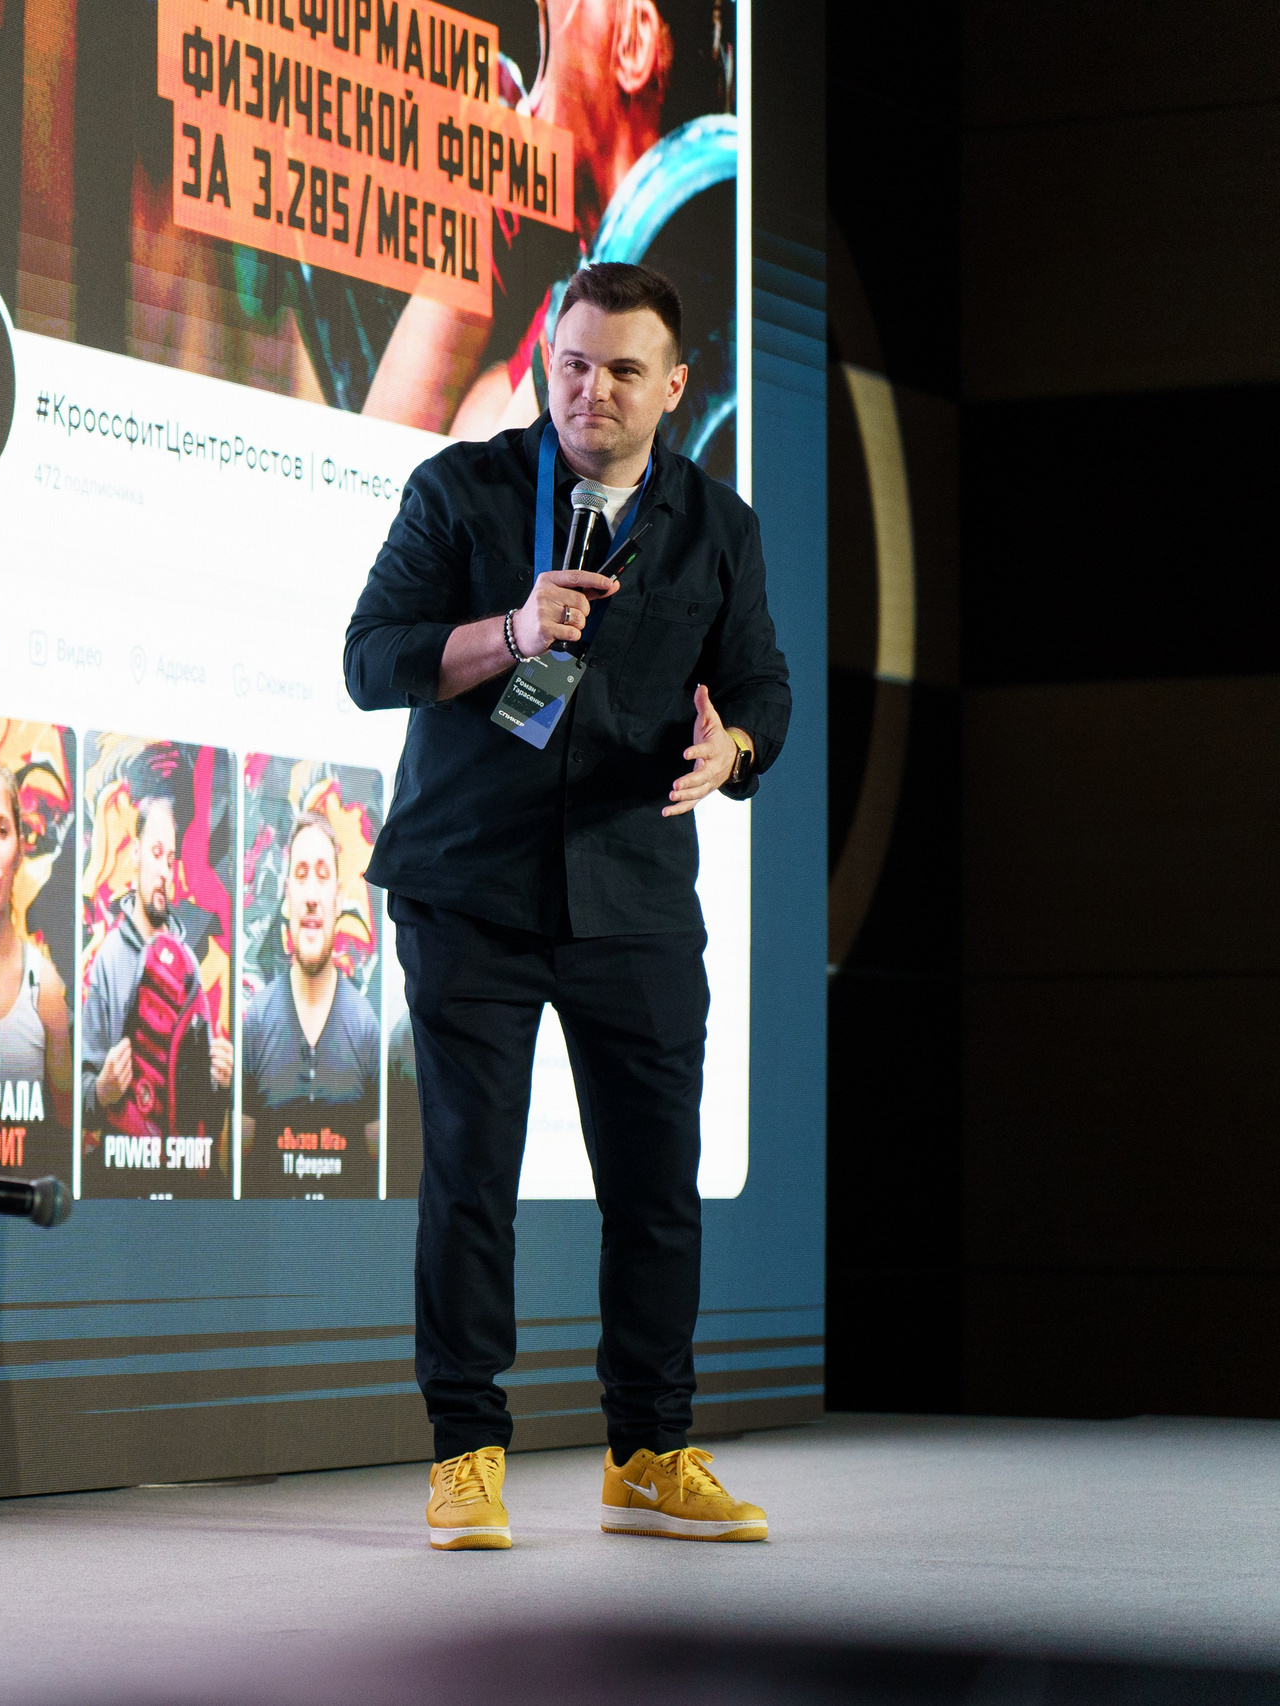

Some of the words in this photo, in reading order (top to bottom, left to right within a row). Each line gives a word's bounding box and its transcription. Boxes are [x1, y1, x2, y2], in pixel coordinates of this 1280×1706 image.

[183, 26, 419, 172] ФИЗИЧЕСКОЙ
[437, 116, 557, 217] ФОРМЫ
[183, 123, 231, 208] ЗА
[253, 147, 479, 283] 3.285/МЕСЯЦ
[36, 390, 304, 482] #КроссфитЦентрРостов
[34, 463, 61, 492] 472
[56, 637, 102, 670] Видео
[157, 655, 206, 686] Адреса
[515, 676, 537, 694] Роман
[512, 684, 545, 708] Тарасенко
[498, 709, 525, 727] СПИКЕР
[105, 1135, 161, 1169] POWER
[166, 1136, 213, 1169] SPORT
[283, 1153, 294, 1174] 11
[295, 1153, 342, 1179] февраля
